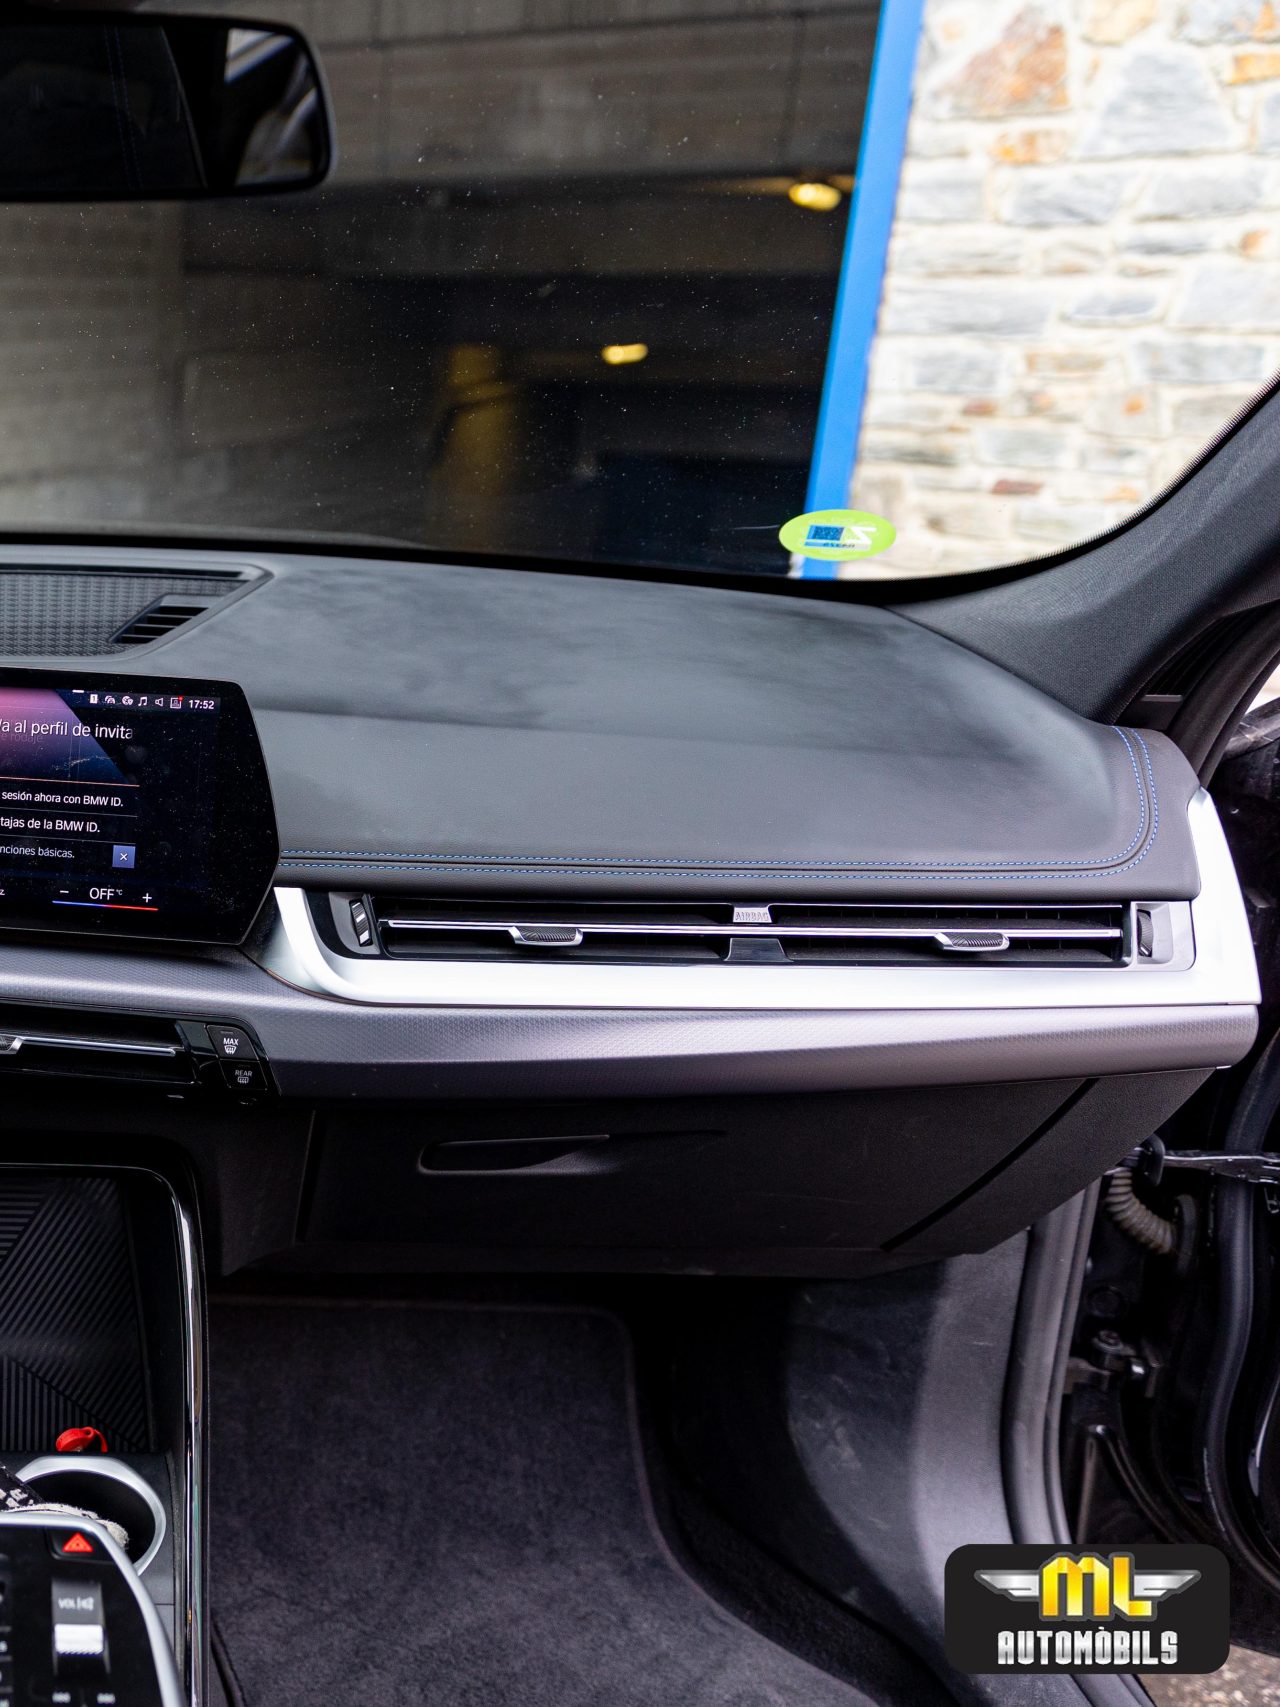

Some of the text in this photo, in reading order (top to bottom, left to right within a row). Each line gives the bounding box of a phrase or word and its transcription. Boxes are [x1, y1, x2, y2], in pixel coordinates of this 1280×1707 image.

[188, 699, 215, 710] 17:52
[14, 719, 27, 733] al
[31, 721, 68, 737] perfil
[72, 723, 91, 737] de
[2, 790, 32, 801] sesión
[34, 792, 61, 804] ahora
[63, 796, 81, 804] con
[83, 795, 109, 806] BMW
[111, 797, 124, 807] ID.
[27, 818, 41, 829] de
[43, 819, 53, 830] la
[55, 820, 84, 832] BMW
[86, 821, 101, 833] ID.
[38, 847, 75, 859] básicas.
[89, 887, 115, 900] OFF
[735, 911, 770, 922] AIRBAG
[223, 1037, 239, 1046] MAX
[234, 1069, 253, 1077] REAR
